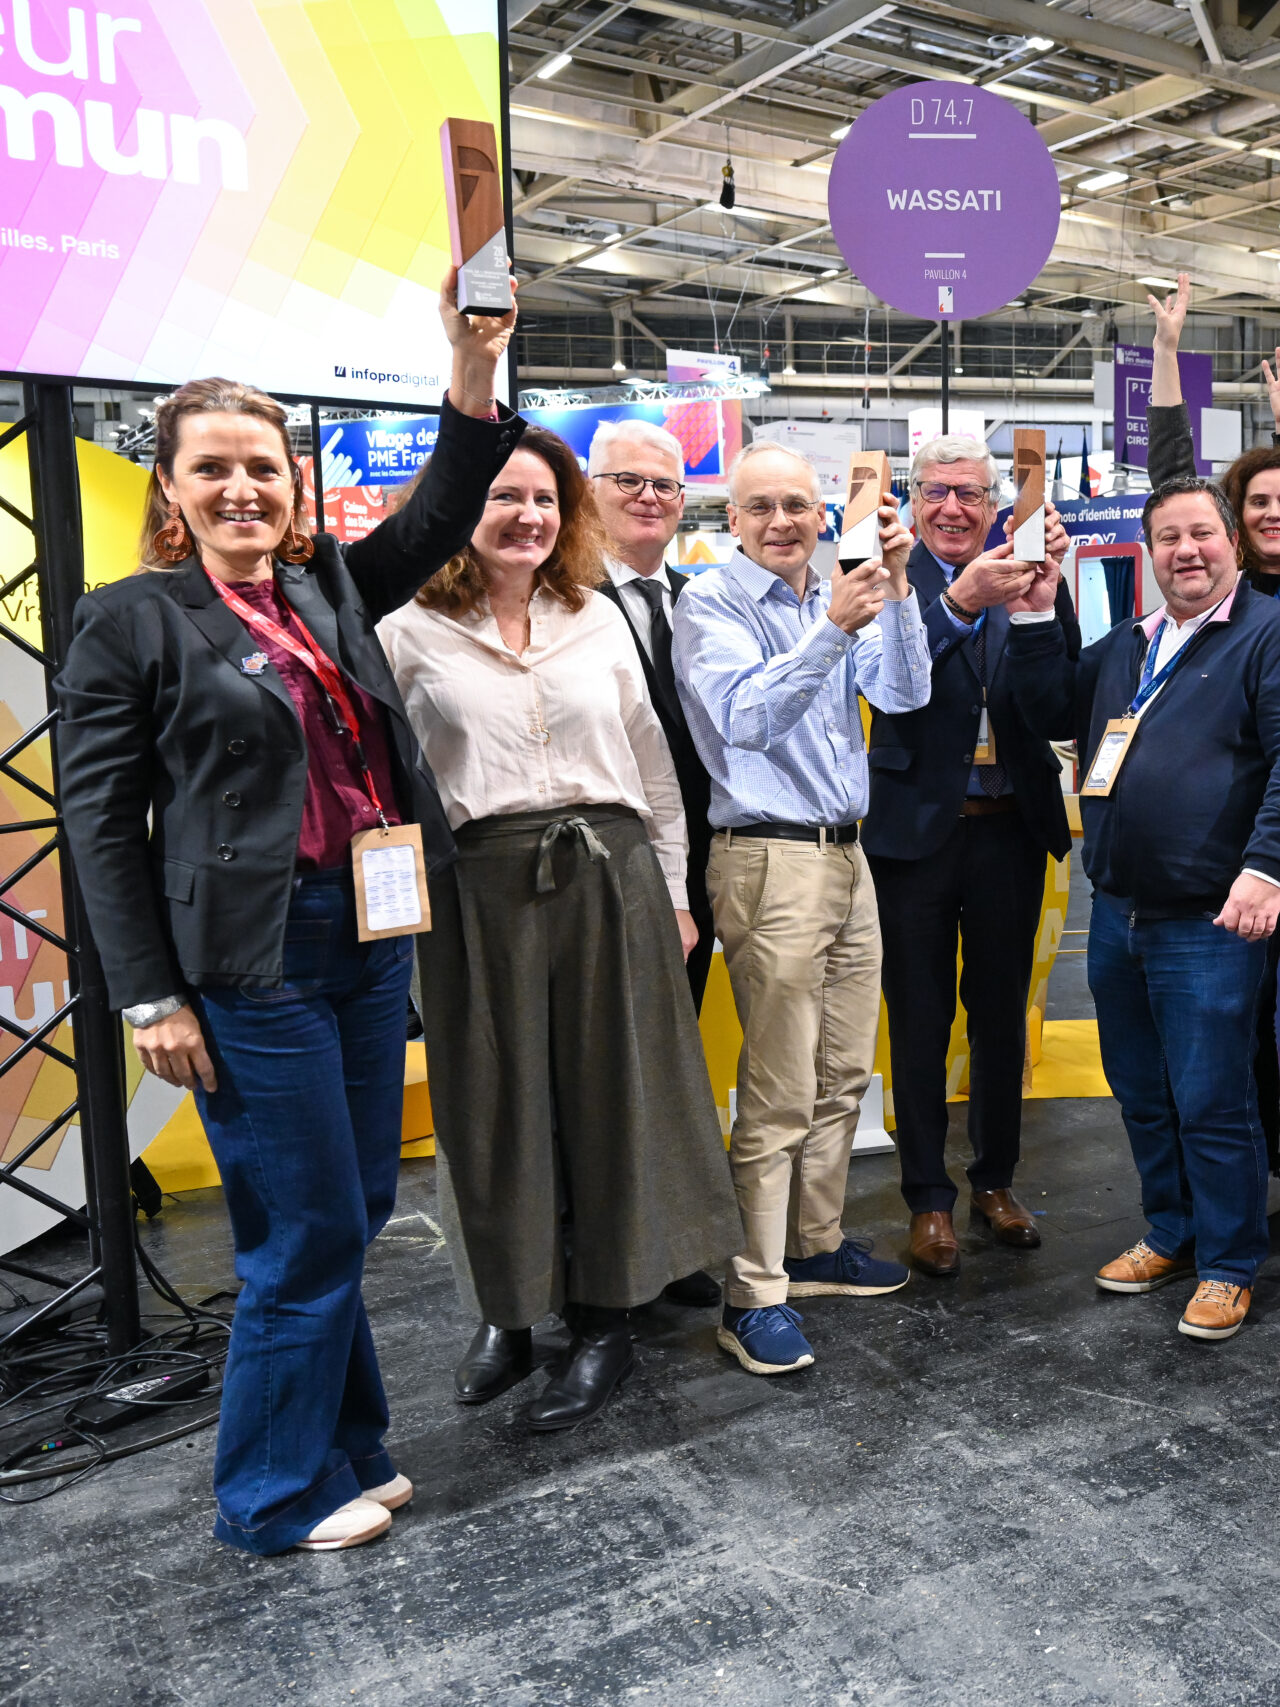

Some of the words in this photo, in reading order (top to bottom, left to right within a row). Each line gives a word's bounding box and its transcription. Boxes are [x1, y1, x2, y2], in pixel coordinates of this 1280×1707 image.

[911, 98, 925, 125] D
[931, 98, 974, 125] 74.7
[886, 188, 1001, 211] WASSATI
[61, 234, 120, 260] Paris
[924, 269, 961, 280] PAVILLON
[961, 269, 967, 280] 4
[728, 361, 737, 371] 4
[351, 367, 440, 388] infoprodigital
[1126, 421, 1139, 432] DE
[366, 429, 414, 451] Village
[368, 449, 399, 468] PME
[1078, 506, 1121, 521] d'identité
